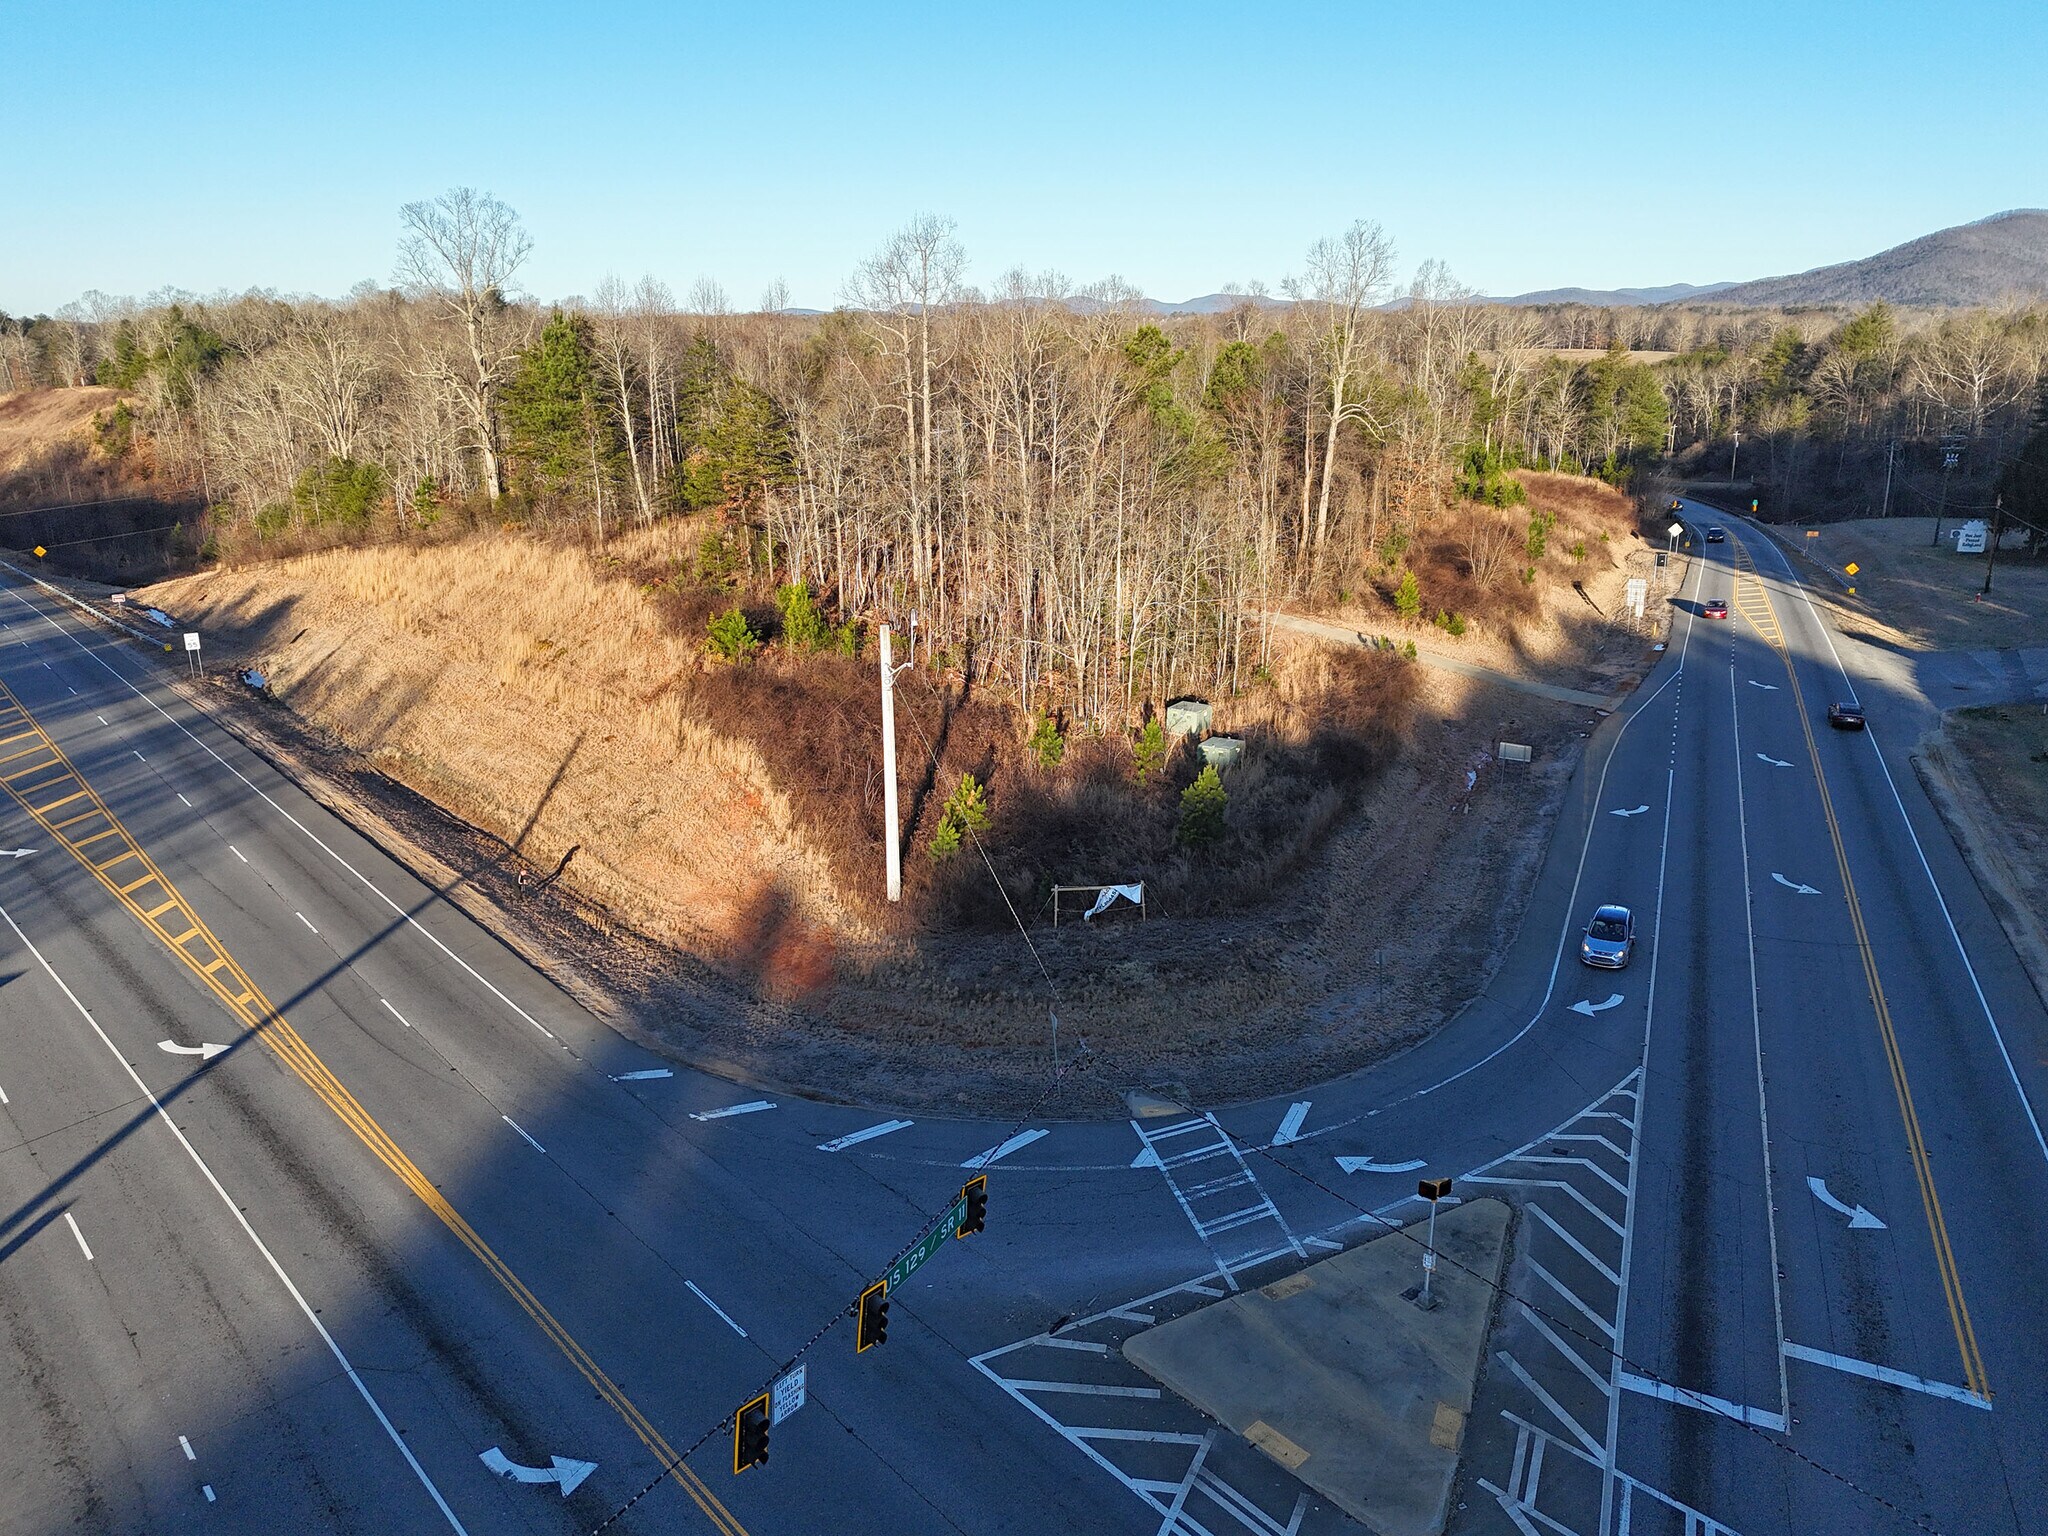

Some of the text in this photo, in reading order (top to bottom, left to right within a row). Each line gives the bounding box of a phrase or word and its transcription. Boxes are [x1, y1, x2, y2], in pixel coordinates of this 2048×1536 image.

[906, 1246, 926, 1274] 129
[941, 1216, 955, 1239] SR
[958, 1204, 966, 1221] 11
[776, 1379, 788, 1391] LEFT
[780, 1379, 798, 1395] YIELD
[779, 1394, 799, 1411] YELLOW
[780, 1402, 798, 1417] ARROW
